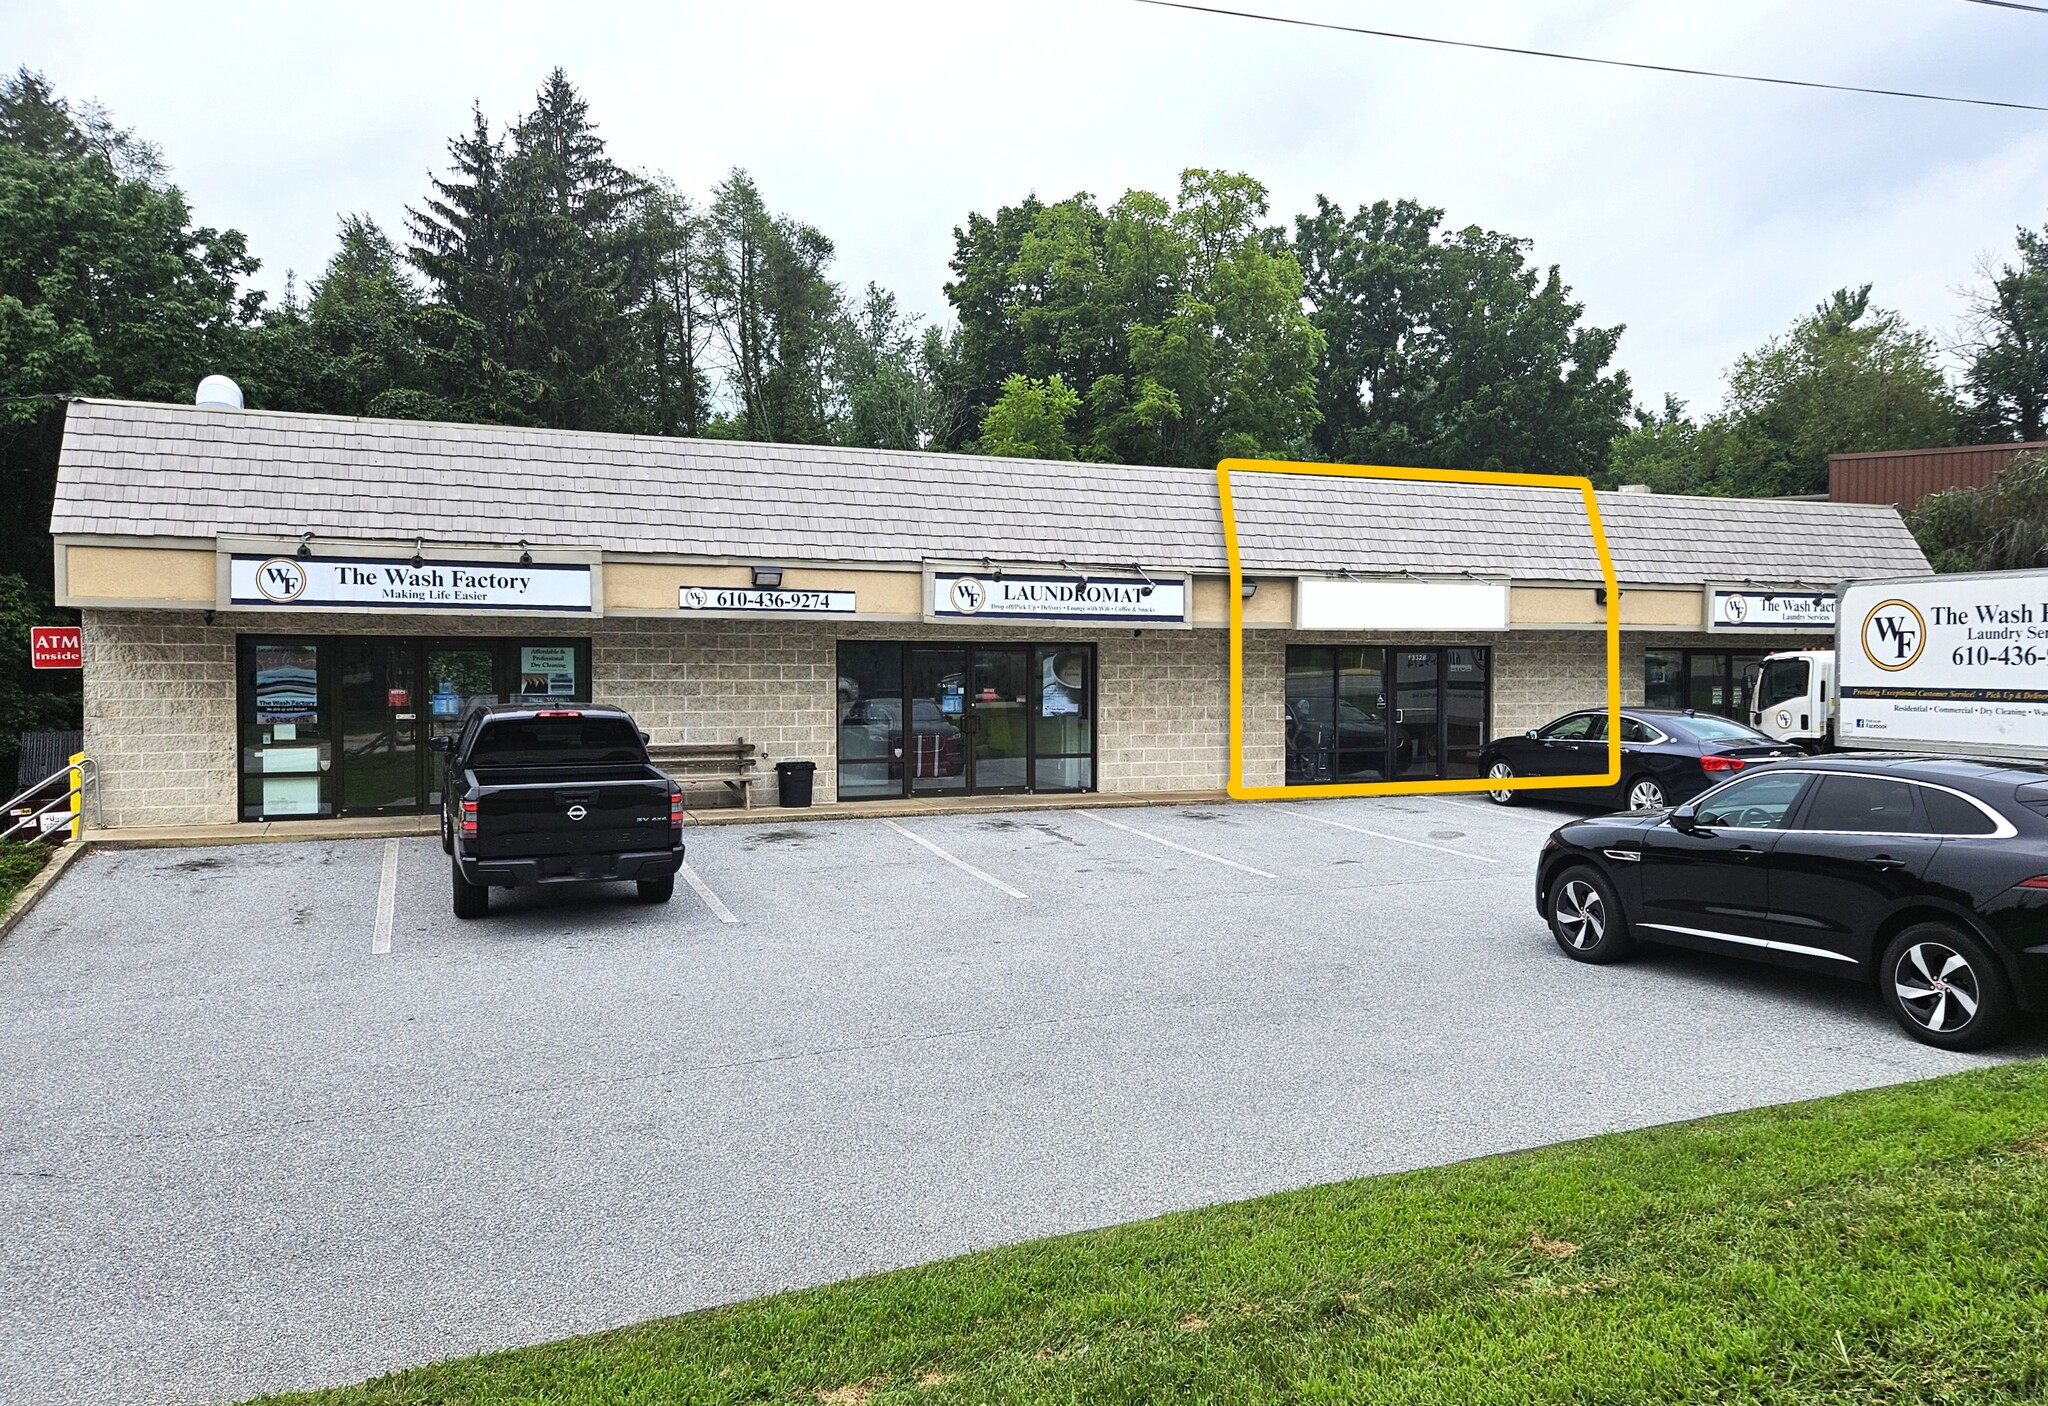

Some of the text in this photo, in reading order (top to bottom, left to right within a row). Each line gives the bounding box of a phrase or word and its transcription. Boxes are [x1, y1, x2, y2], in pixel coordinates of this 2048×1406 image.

[334, 567, 531, 594] The Wash Factory
[382, 589, 488, 601] Making Life Easier
[717, 592, 830, 609] 610-436-9274
[1004, 585, 1142, 603] LAUNDROMAT
[990, 603, 1005, 611] Drop
[1067, 605, 1086, 613] Lounge
[1760, 599, 1780, 612] The
[1783, 600, 1811, 613] Wash
[1782, 613, 1830, 622] Laundry Services
[1931, 606, 1969, 625] The
[1975, 604, 2033, 624] Wash
[36, 635, 79, 649] ATM
[1968, 627, 2022, 643] Laundry
[36, 652, 80, 660] Inside
[1952, 645, 2048, 666] 610-436-
[1853, 688, 1881, 697] Providing
[1881, 689, 1917, 698] Exceptional
[1985, 691, 2001, 699] Pick
[2002, 691, 2015, 700] Up
[1894, 704, 1928, 713] Residential
[1934, 705, 1974, 714] Commercial
[1980, 707, 1993, 716] Dry
[1995, 708, 2027, 717] Cleaning
